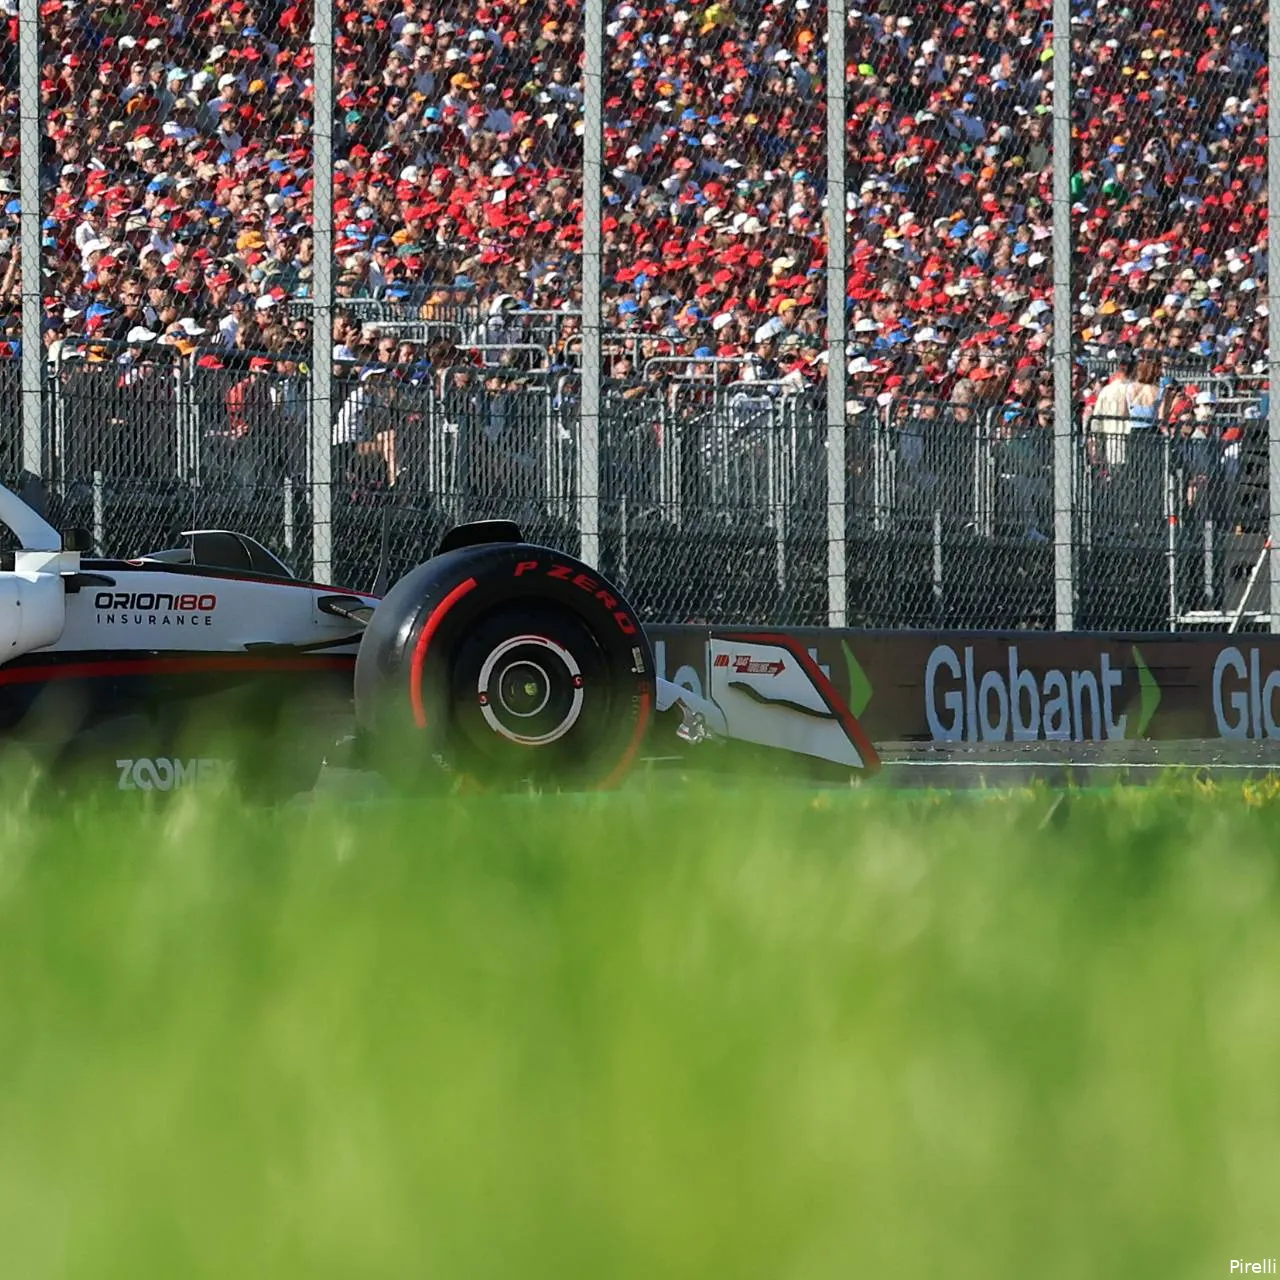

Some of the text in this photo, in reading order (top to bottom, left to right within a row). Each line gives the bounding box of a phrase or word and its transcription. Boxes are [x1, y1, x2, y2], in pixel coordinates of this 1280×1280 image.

[95, 592, 217, 611] ORION180
[96, 614, 212, 626] INSURANCE
[513, 561, 636, 635] P ZERO
[925, 644, 1127, 742] Globant
